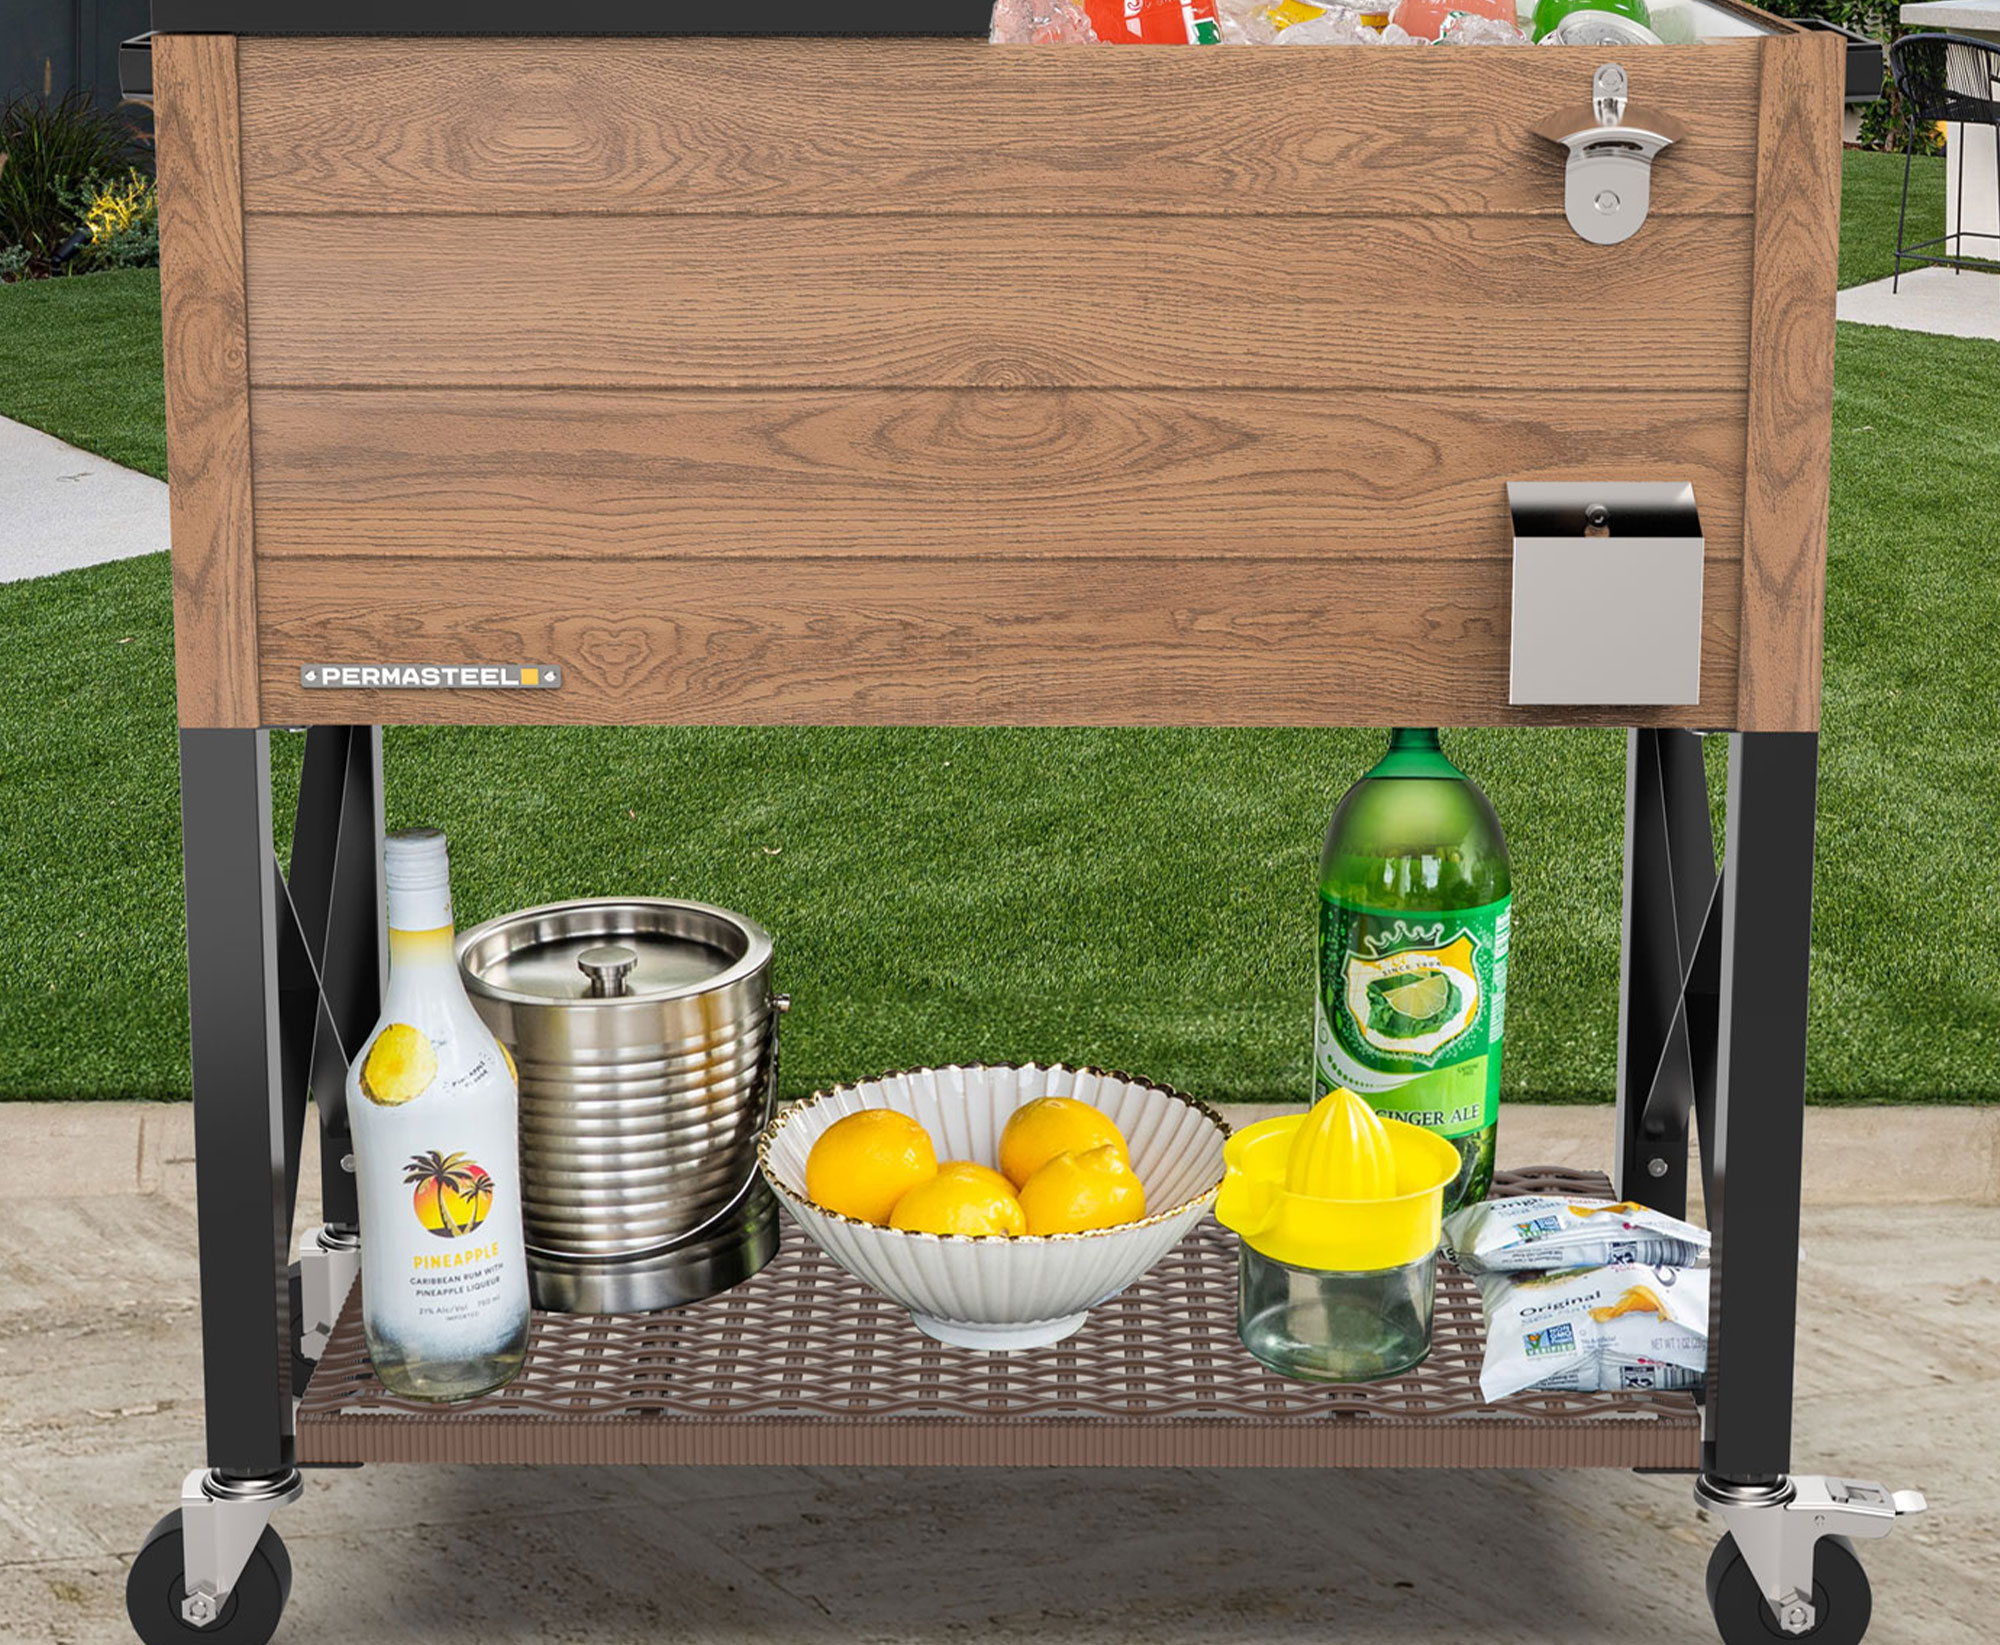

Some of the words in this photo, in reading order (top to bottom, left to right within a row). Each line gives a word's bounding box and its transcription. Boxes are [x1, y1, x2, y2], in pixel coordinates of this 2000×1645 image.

[322, 667, 519, 686] PERMASTEEL
[1450, 1104, 1480, 1123] ALE
[413, 1241, 499, 1270] PINEAPPLE
[409, 1275, 461, 1286] CARIBBEAN
[463, 1270, 482, 1280] RUM
[484, 1263, 504, 1275] WITH
[415, 1286, 464, 1297] PINEAPPLE
[466, 1276, 500, 1293] LIQUEUR
[1519, 1290, 1601, 1317] Original
